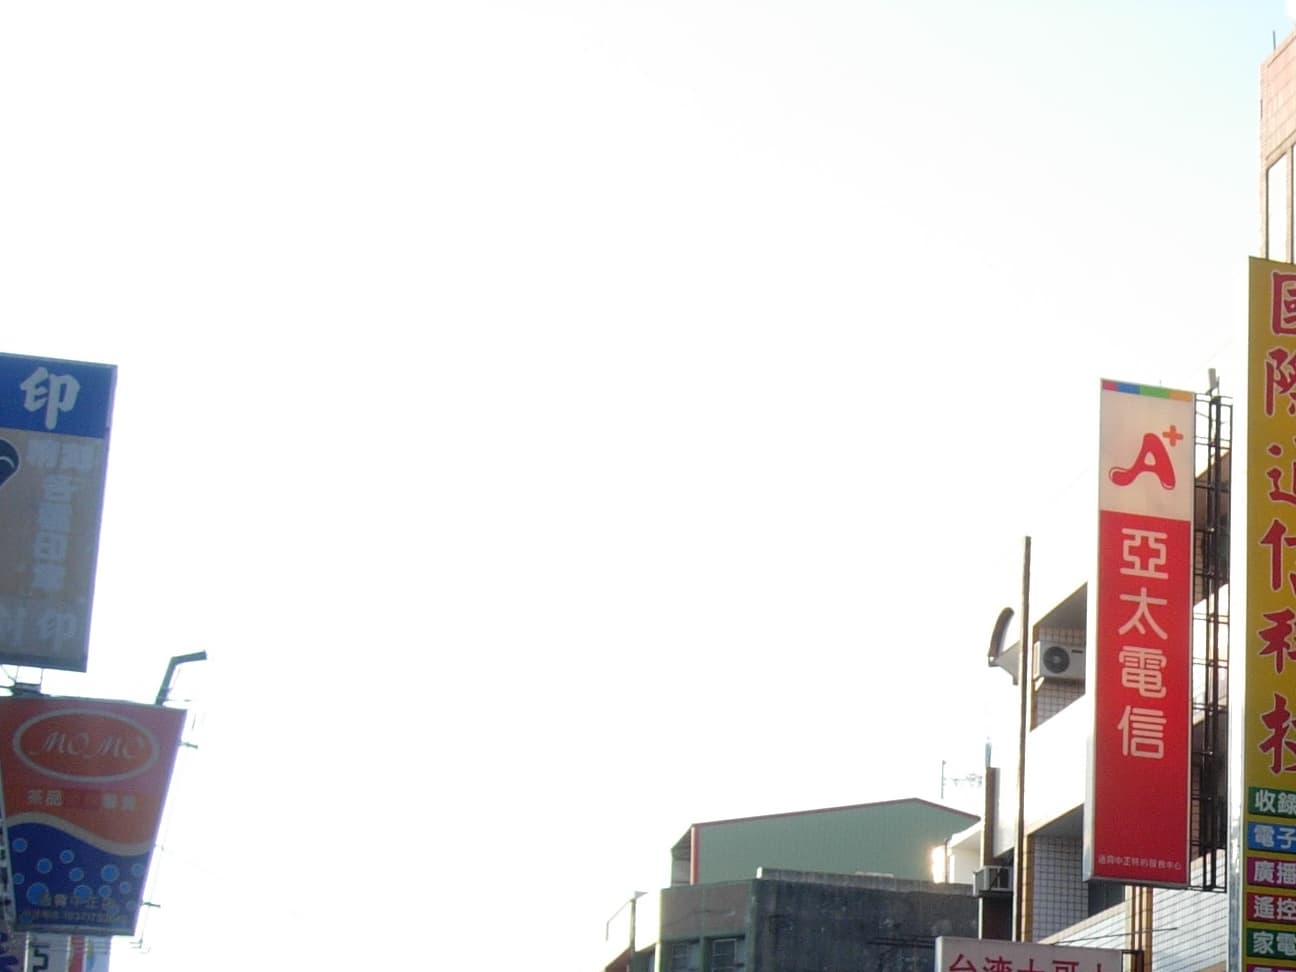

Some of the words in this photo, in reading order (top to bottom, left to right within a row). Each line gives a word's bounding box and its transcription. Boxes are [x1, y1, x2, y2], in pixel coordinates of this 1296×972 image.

[20, 366, 80, 430] 印
[1118, 527, 1169, 760] 亞太電信
